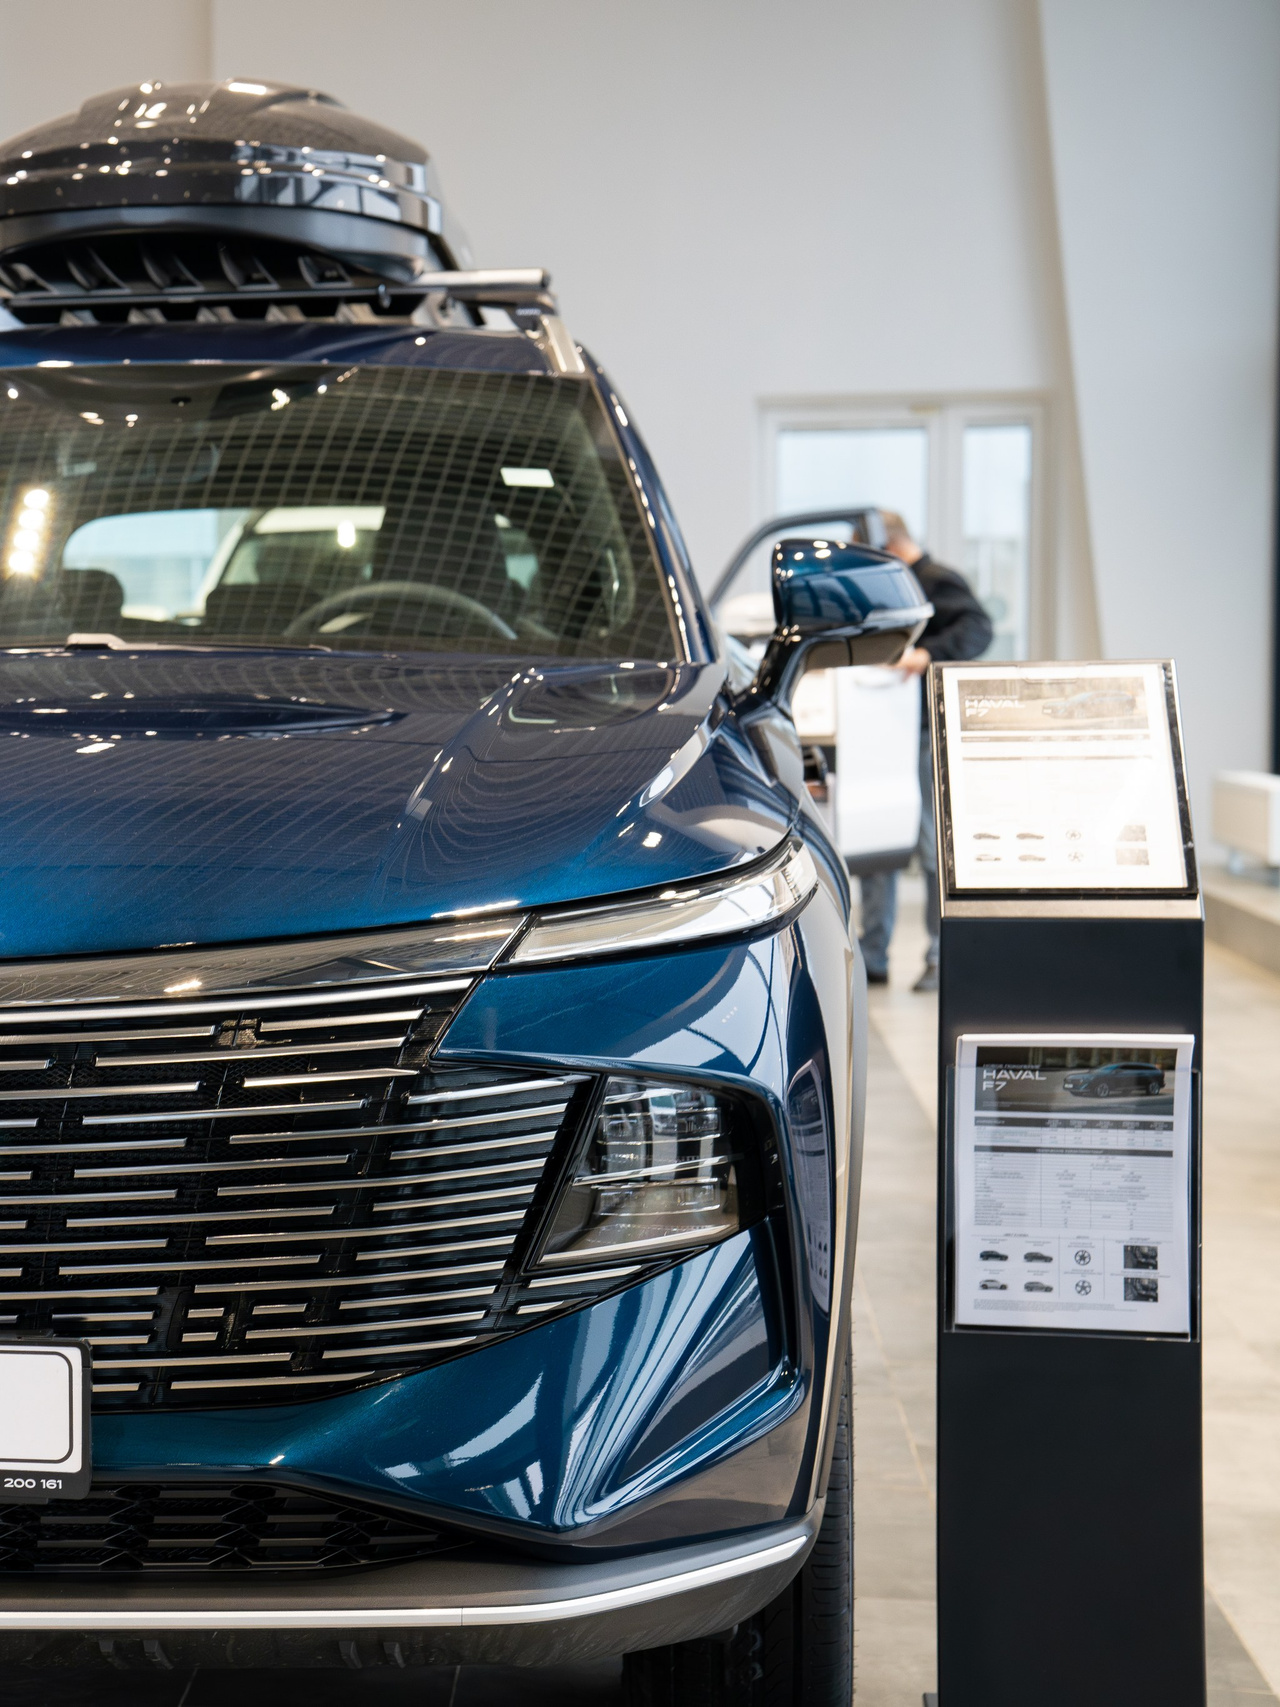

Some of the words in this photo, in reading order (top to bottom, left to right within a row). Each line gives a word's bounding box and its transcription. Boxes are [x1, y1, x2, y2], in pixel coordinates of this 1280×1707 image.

[964, 699, 1026, 708] HAVAL
[982, 1069, 1047, 1080] HAVAL
[982, 1081, 1007, 1091] F7
[4, 1478, 36, 1489] 200
[40, 1479, 63, 1490] 161
